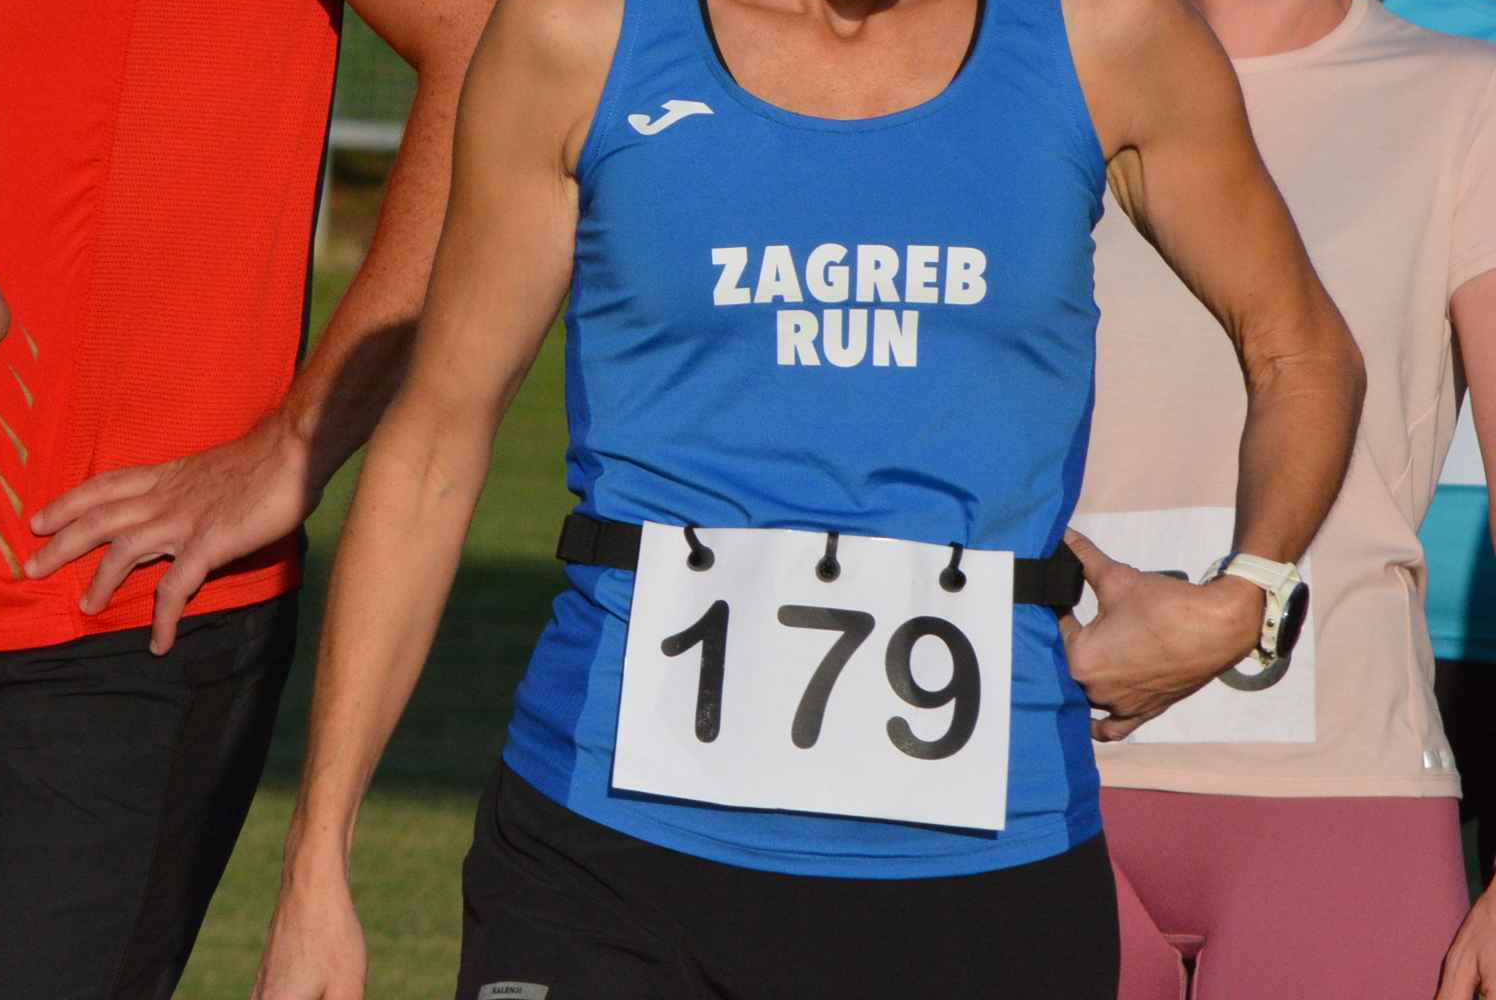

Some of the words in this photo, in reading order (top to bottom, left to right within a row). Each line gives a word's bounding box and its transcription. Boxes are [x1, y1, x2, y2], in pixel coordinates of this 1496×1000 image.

[711, 242, 988, 306] ZAGREB
[776, 308, 919, 368] RUN
[660, 599, 982, 761] 179
